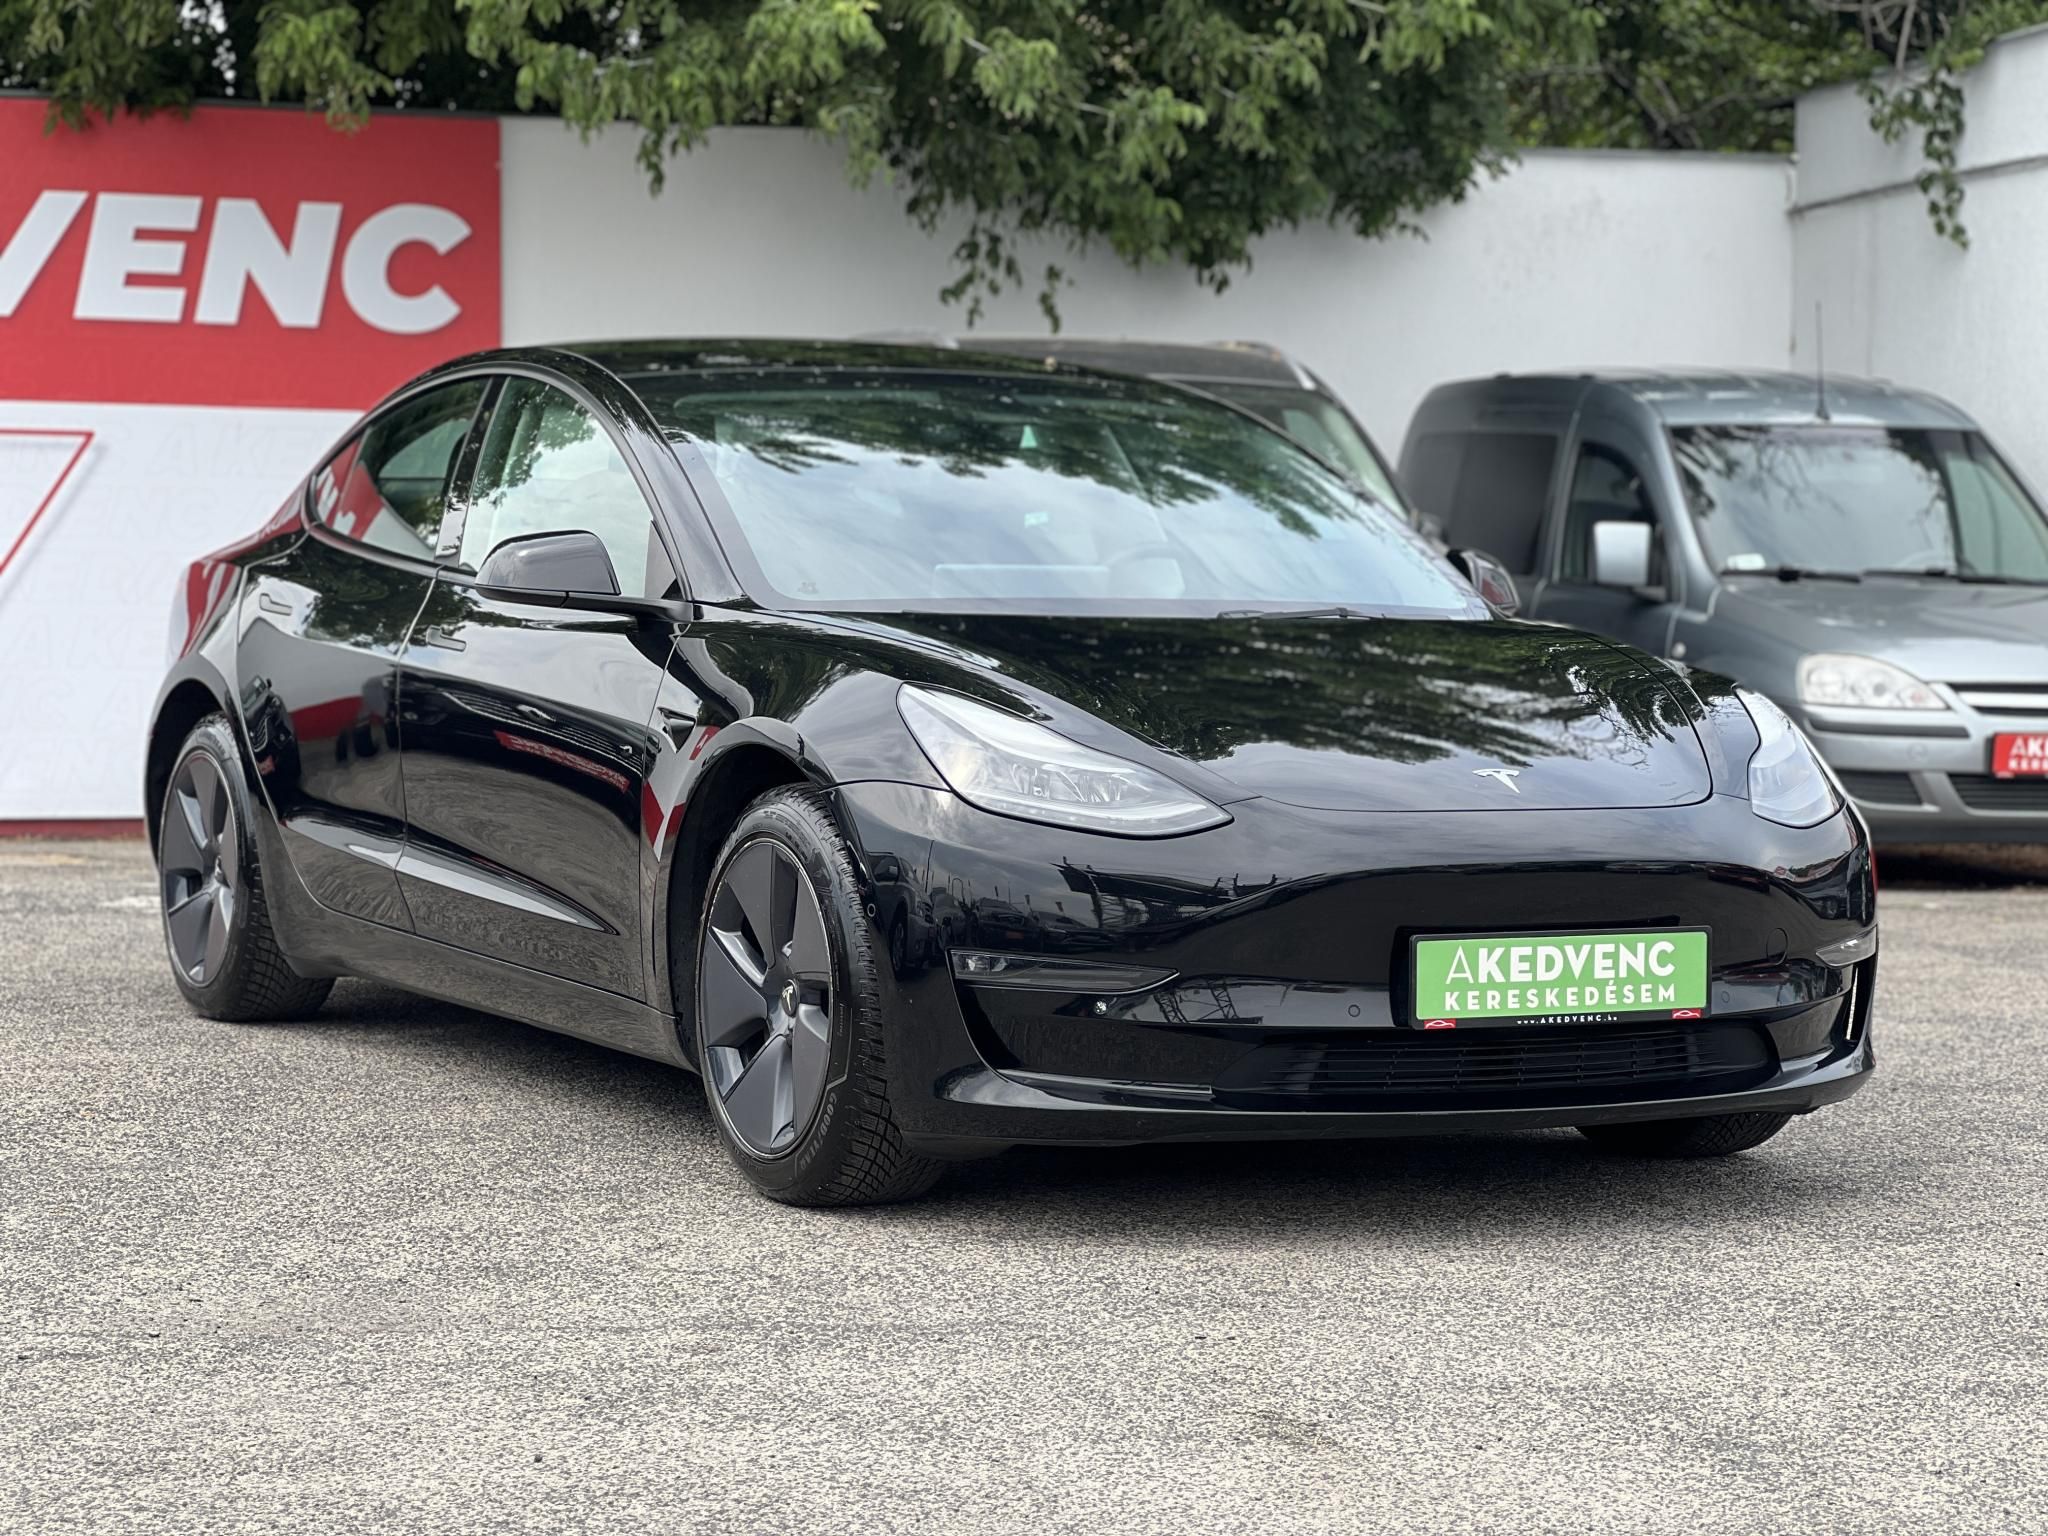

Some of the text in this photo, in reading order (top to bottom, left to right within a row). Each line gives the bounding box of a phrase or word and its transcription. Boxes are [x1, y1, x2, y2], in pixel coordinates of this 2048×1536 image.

[2009, 736, 2048, 757] AK
[1445, 941, 1675, 984] AKEDVENC
[1444, 979, 1675, 1011] KERESKEDÉSEM
